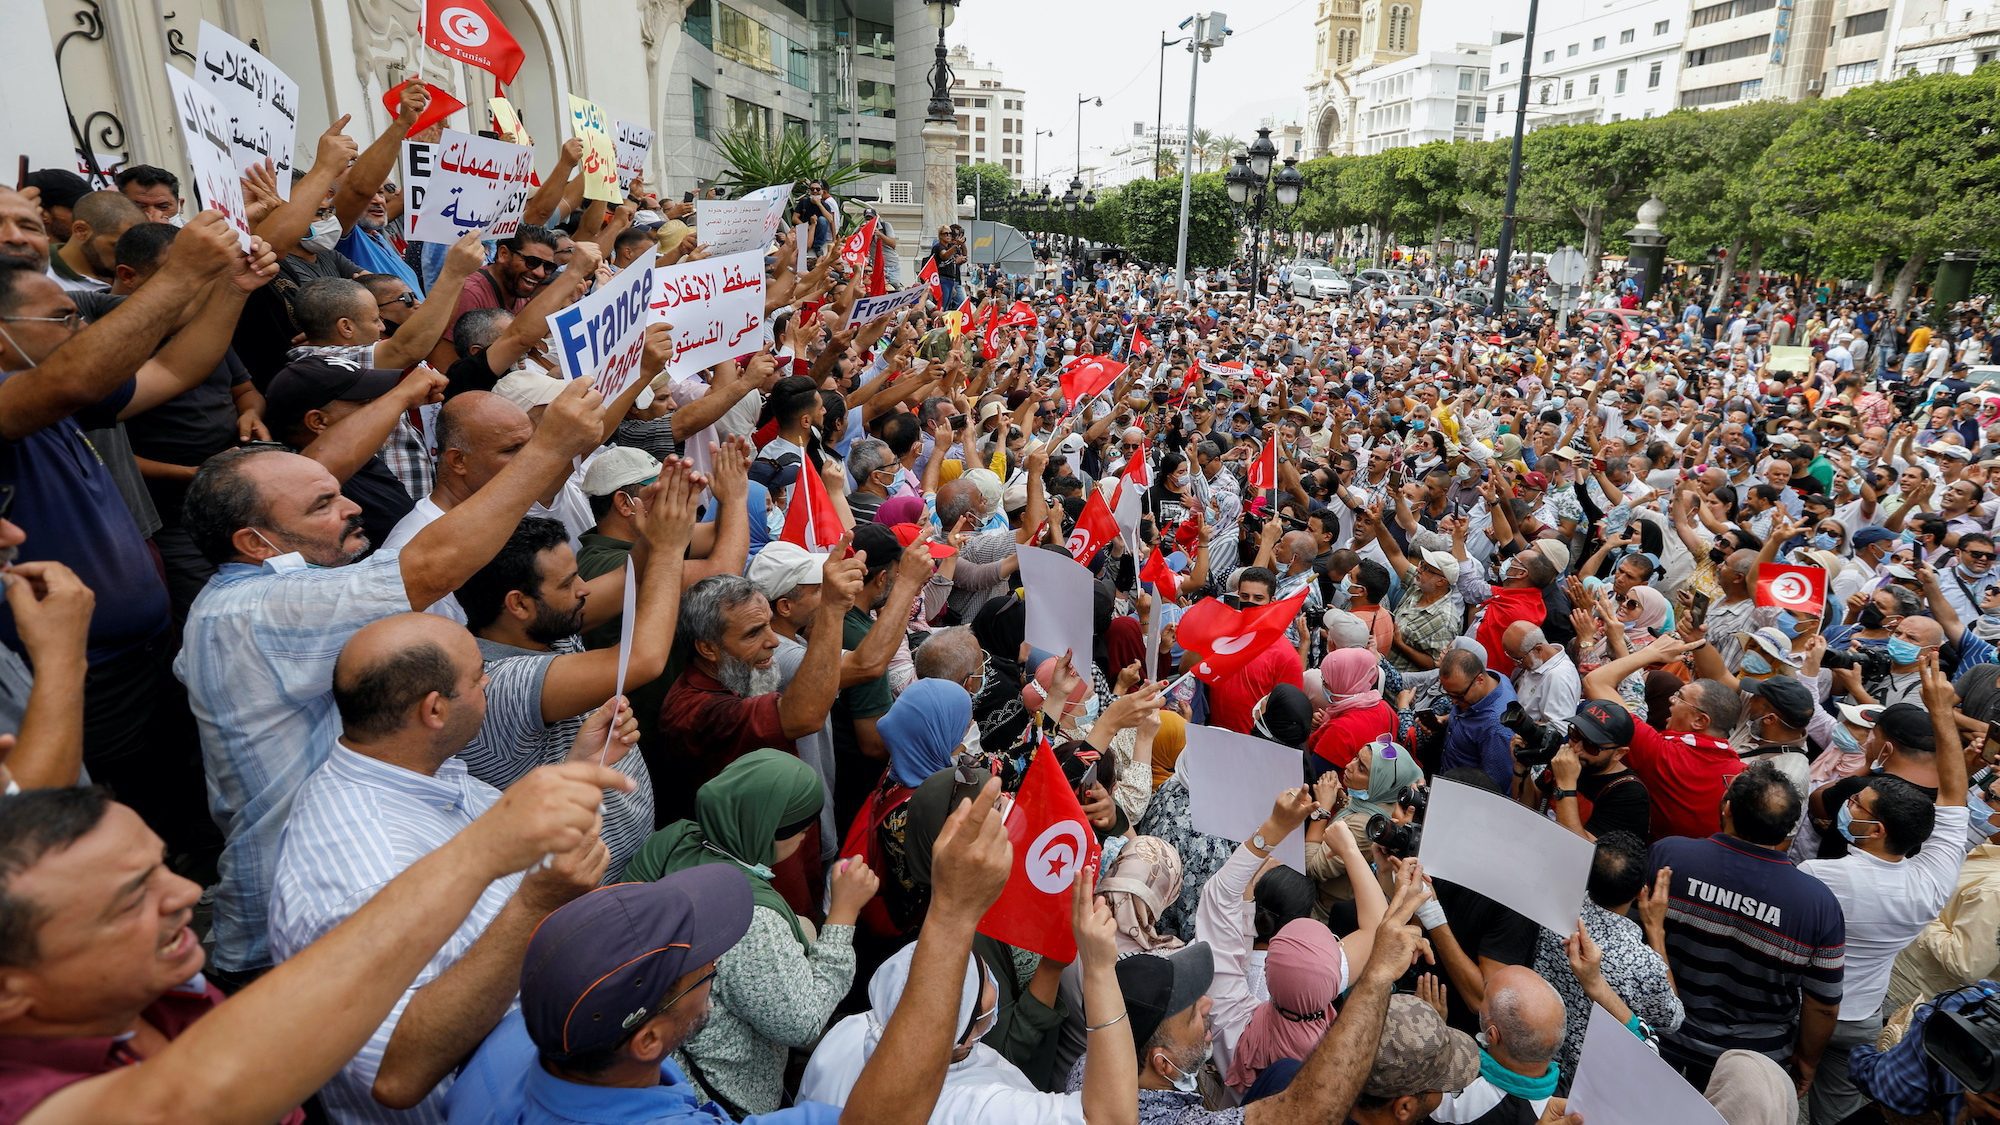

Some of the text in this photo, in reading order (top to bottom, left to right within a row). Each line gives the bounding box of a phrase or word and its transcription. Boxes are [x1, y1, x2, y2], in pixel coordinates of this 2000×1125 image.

[455, 47, 491, 67] Tunisia
[204, 50, 295, 129] يسقط الإنقلاب
[231, 116, 272, 157] الدّست
[650, 264, 761, 317] يسقط الإنقلاب
[852, 288, 925, 320] France
[555, 267, 652, 380] France
[728, 312, 760, 348] على
[594, 330, 645, 399] Gage
[1687, 877, 1781, 928] TUNISIA
